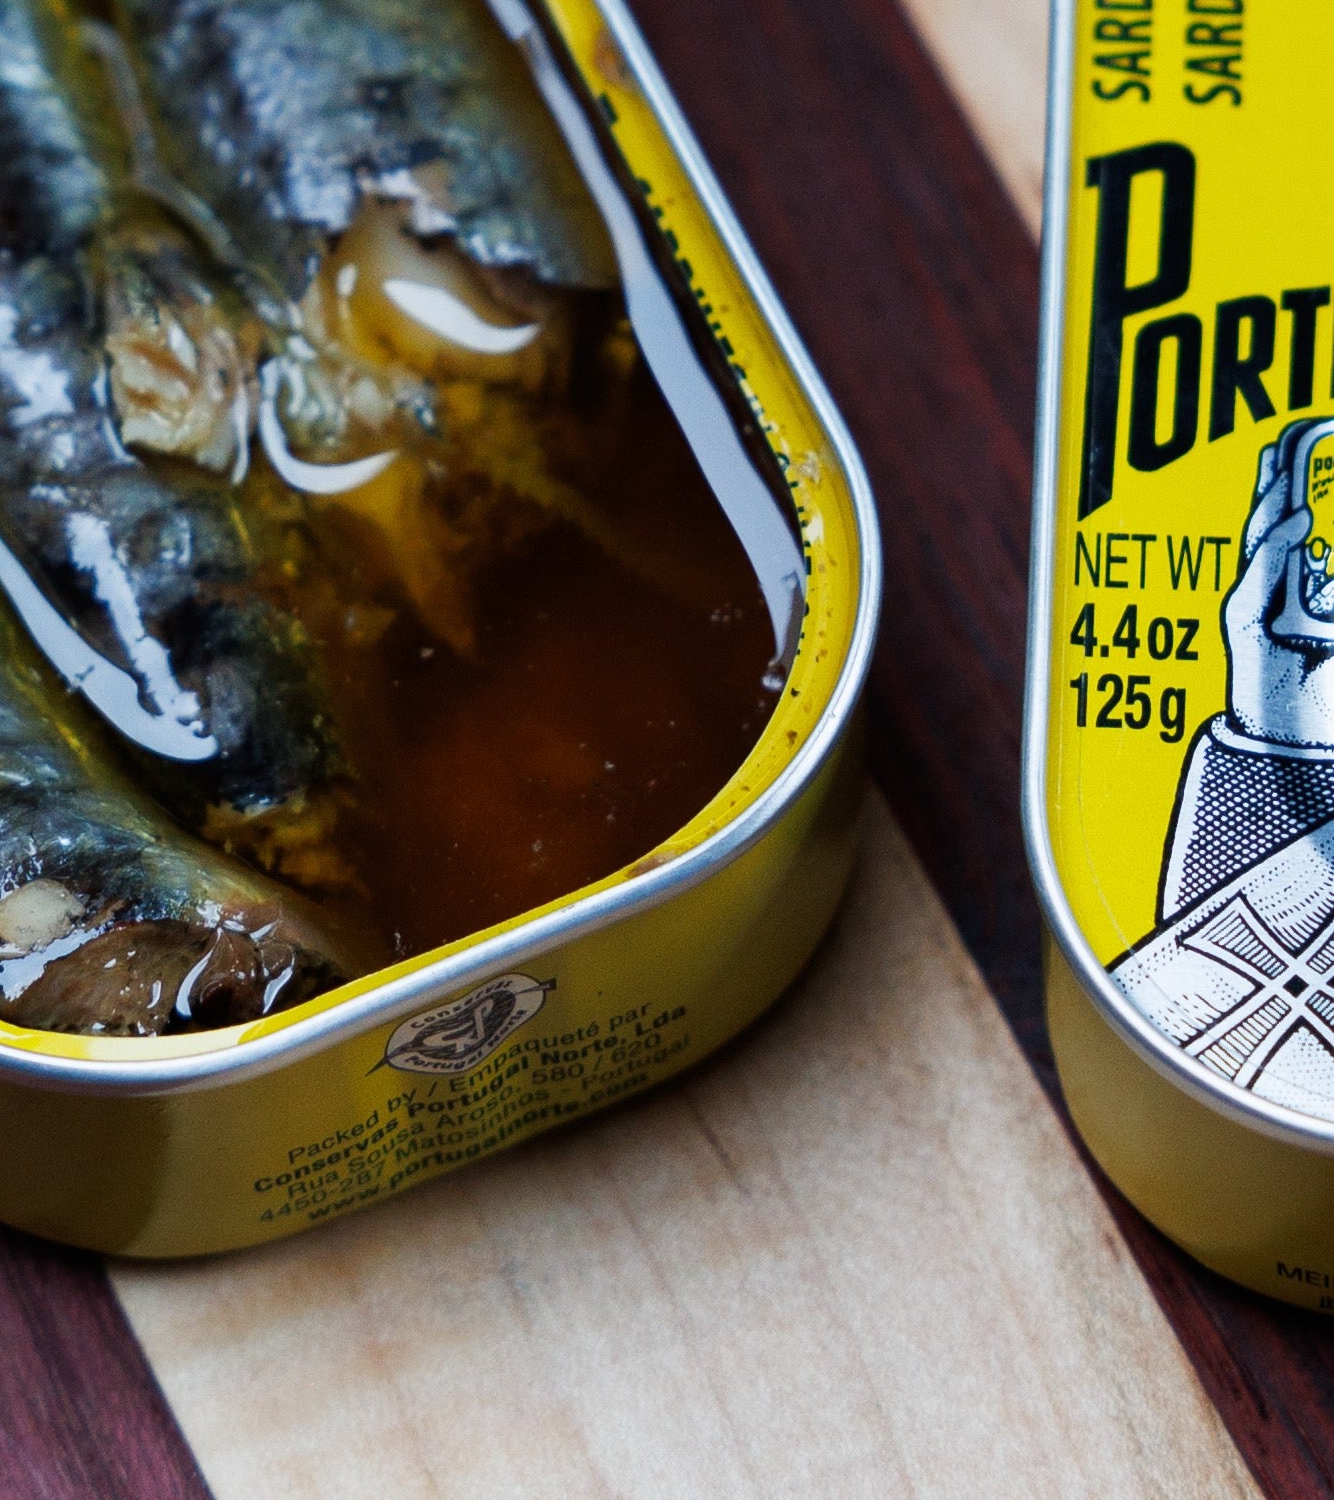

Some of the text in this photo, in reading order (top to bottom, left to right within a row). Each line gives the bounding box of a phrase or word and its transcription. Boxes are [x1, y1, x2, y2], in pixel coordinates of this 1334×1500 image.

[1074, 530, 1232, 591] NET WT
[254, 1117, 399, 1193] Conservas
[407, 1055, 529, 1118] Portugal
[635, 1006, 686, 1037] Lda
[287, 1110, 379, 1165] Packed
[387, 1088, 417, 1113] by
[609, 1002, 652, 1032] par
[287, 1169, 340, 1200] Rua
[348, 1120, 425, 1174] Sousa
[530, 1062, 585, 1087] 580
[394, 1088, 549, 1165] Matosinhos
[581, 1034, 690, 1090] Portugal
